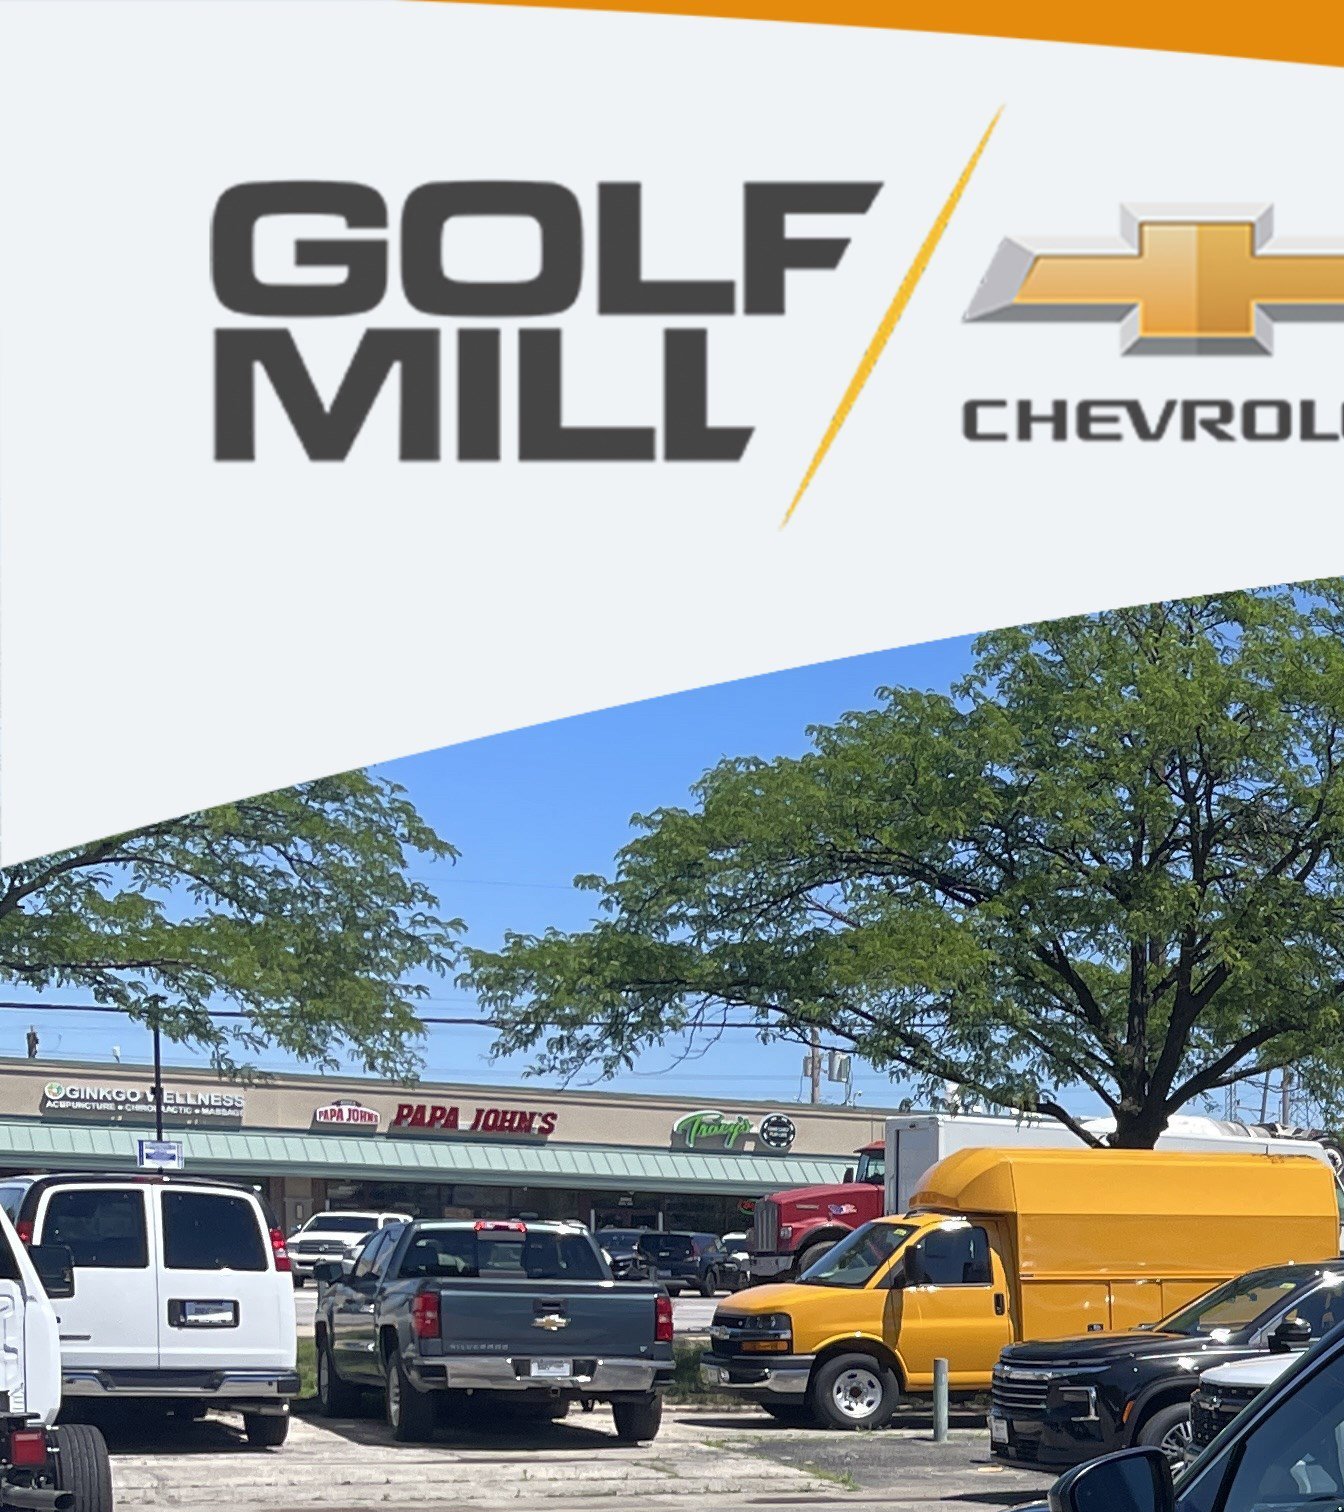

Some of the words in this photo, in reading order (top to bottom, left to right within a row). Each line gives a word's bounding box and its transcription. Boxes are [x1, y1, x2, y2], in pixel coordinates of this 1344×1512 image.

[66, 1086, 141, 1102] GINKGO
[124, 1104, 193, 1115] CHIROACTIC
[318, 1109, 344, 1122] PAPA
[393, 1103, 460, 1129] PAPA
[470, 1108, 558, 1135] JOHN'S
